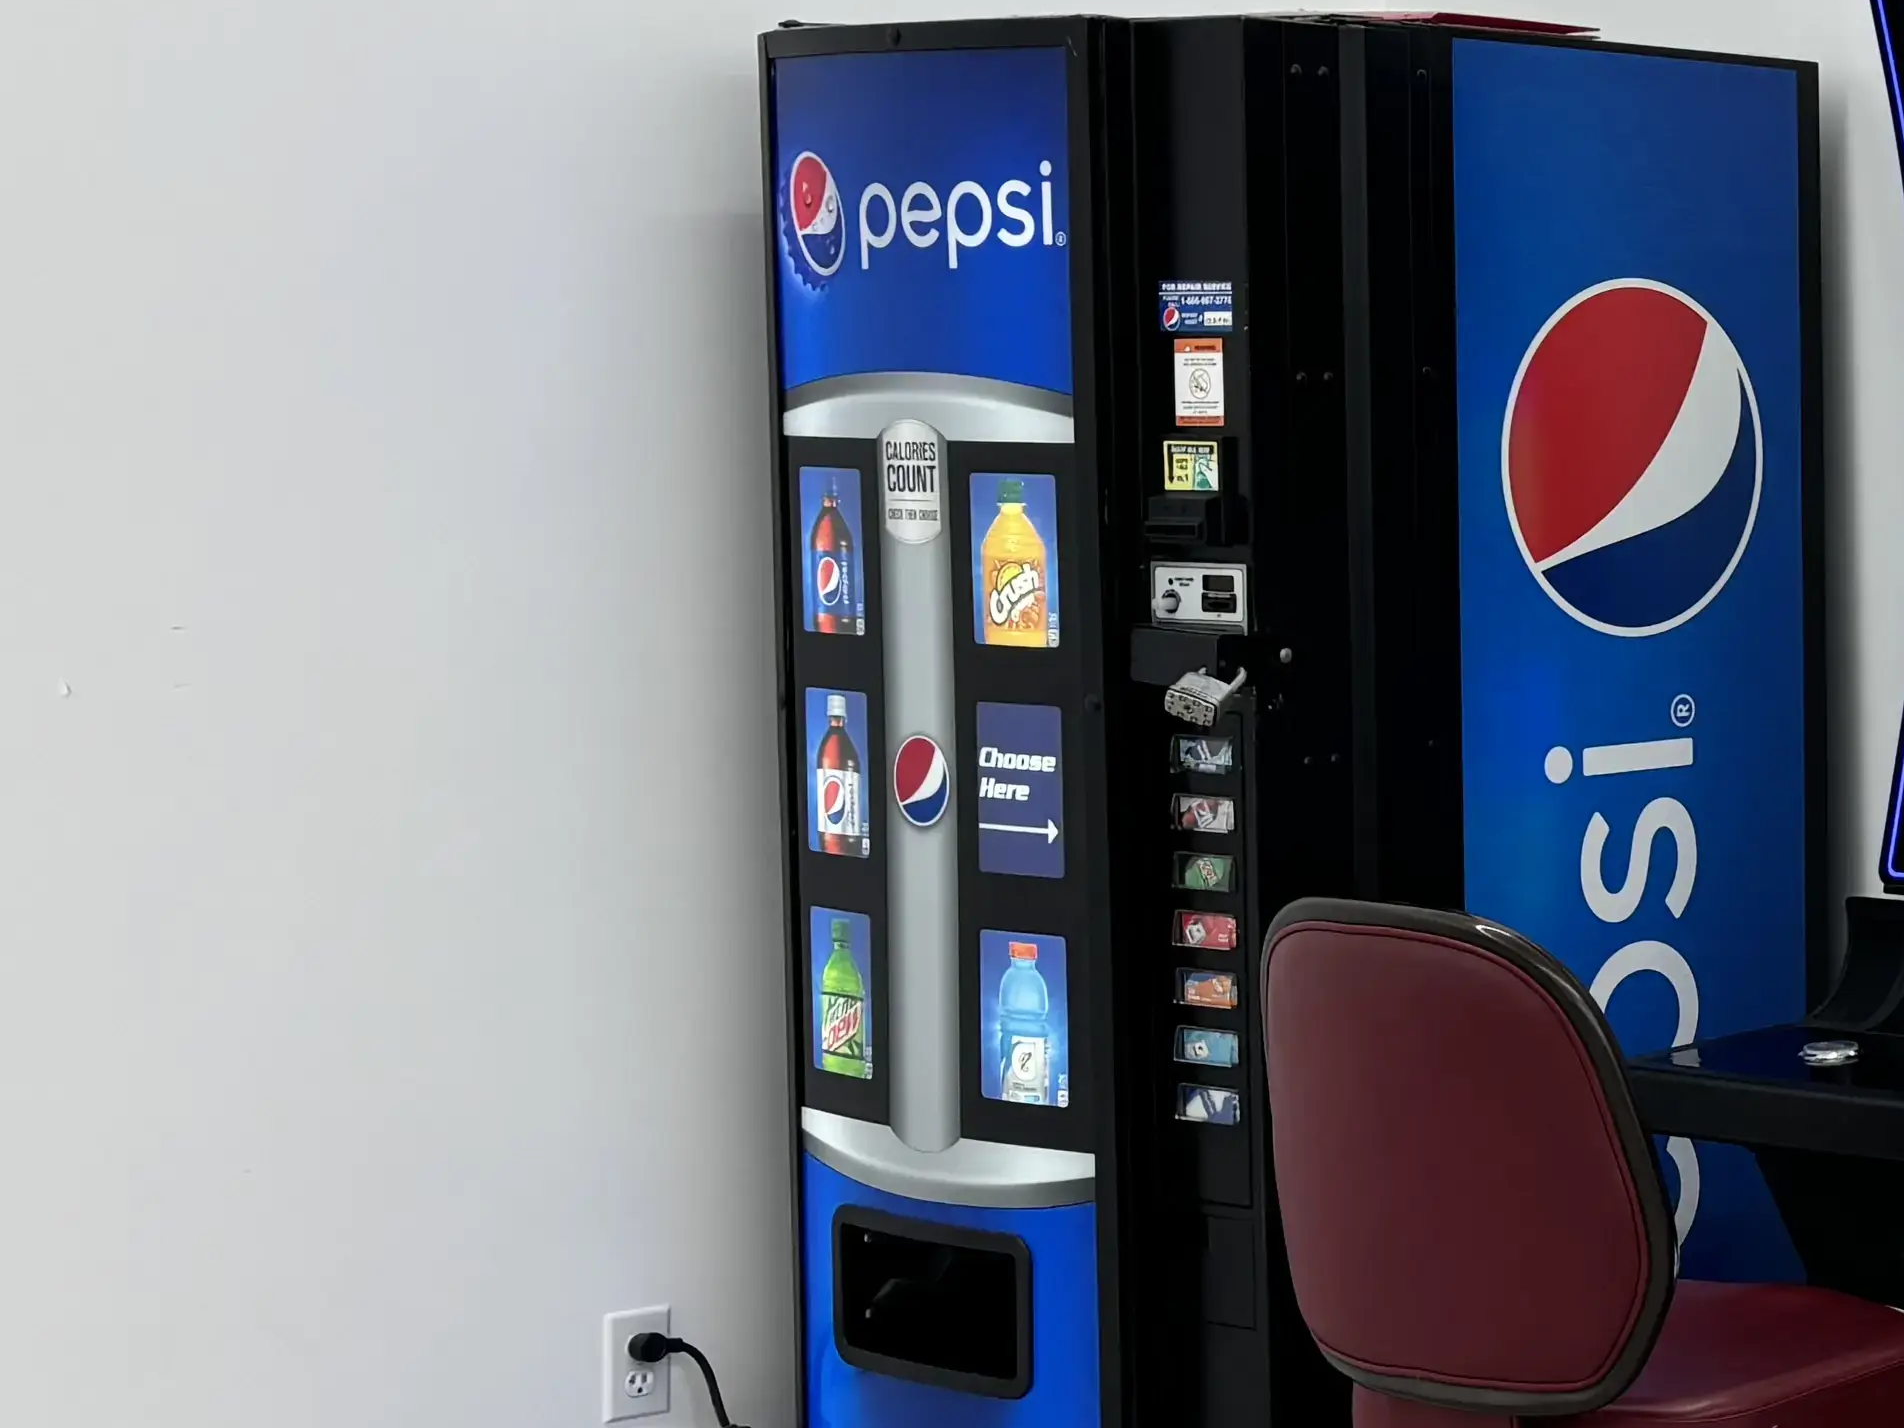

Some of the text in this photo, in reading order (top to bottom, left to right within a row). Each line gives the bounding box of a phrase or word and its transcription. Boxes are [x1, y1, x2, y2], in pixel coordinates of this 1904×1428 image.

[859, 160, 1053, 269] pepsi
[886, 441, 936, 461] CALORIES
[887, 464, 936, 492] COUNT
[979, 747, 1056, 772] Choose
[979, 777, 1030, 801] Here
